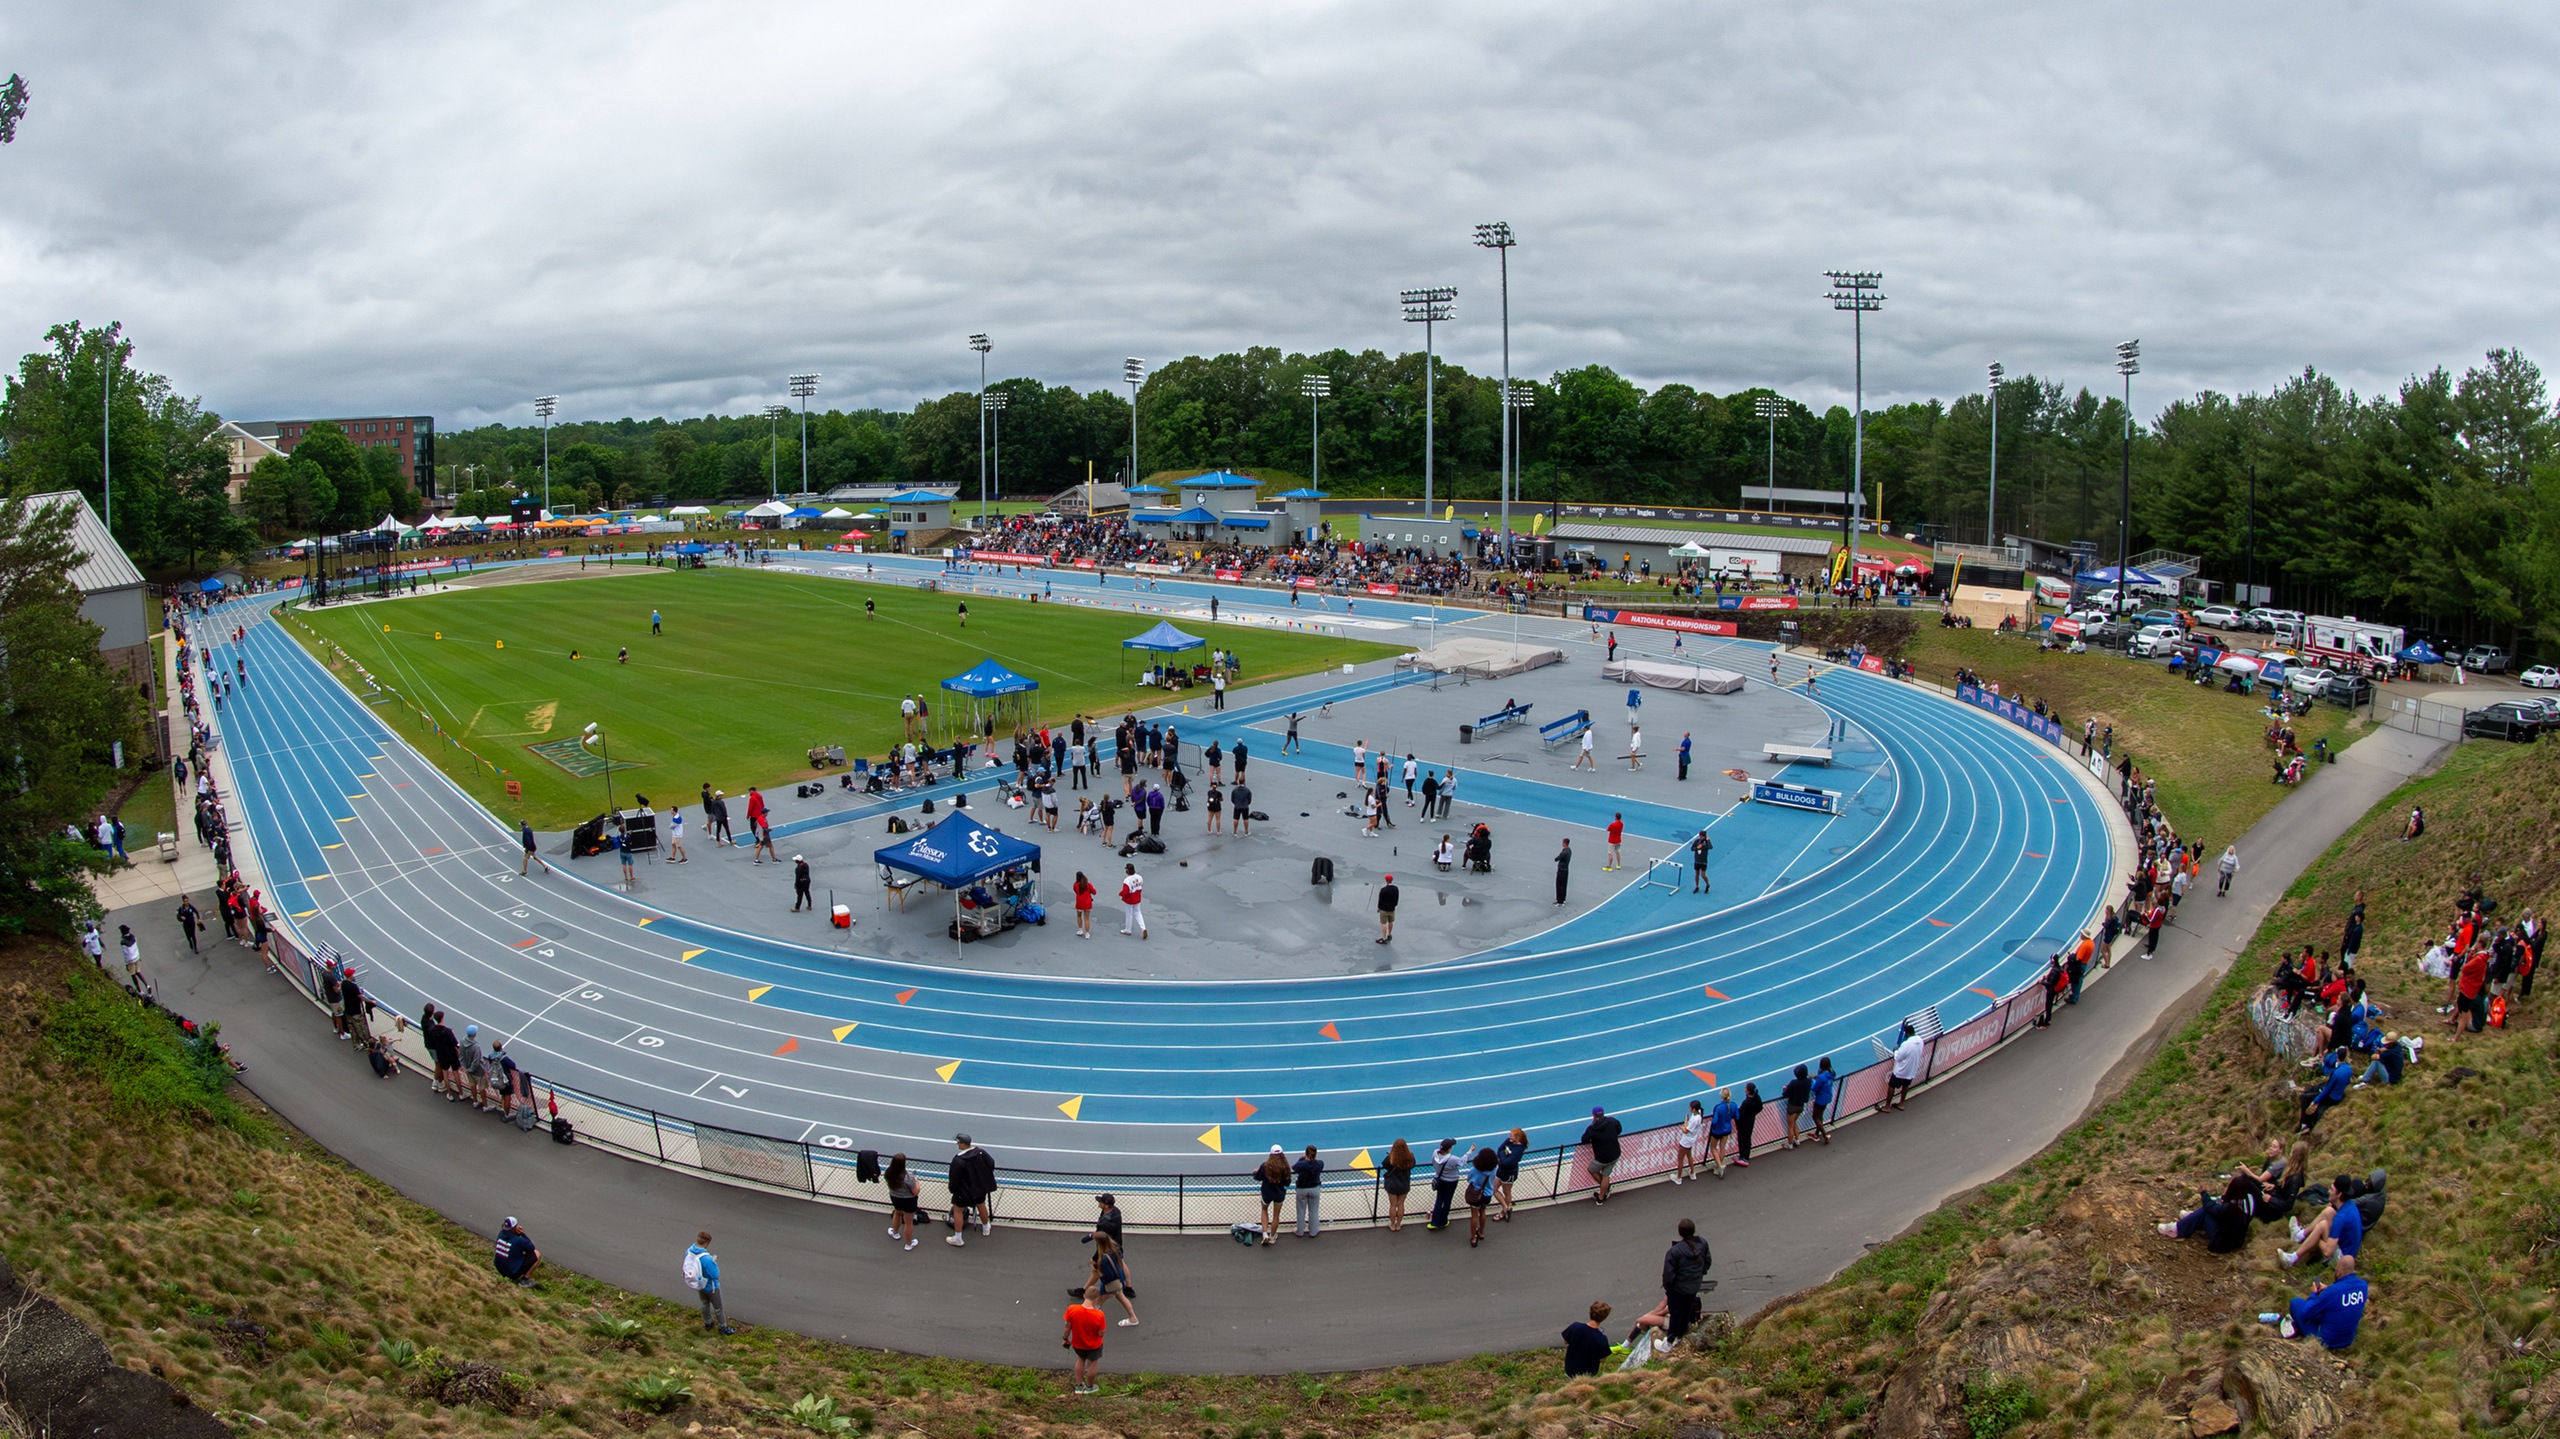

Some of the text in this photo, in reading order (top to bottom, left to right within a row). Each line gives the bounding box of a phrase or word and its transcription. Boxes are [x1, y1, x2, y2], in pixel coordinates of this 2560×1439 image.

[409, 560, 448, 569] CHAMPIONSHIP
[1729, 557, 1741, 565] GO
[1630, 615, 1722, 632] NATIONAL CHAMPIONSHIP
[1775, 792, 1816, 806] BULLDOGS
[538, 947, 555, 959] 4
[580, 989, 605, 1003] 5
[637, 1035, 666, 1048] 6
[719, 1084, 750, 1099] 7
[818, 1134, 854, 1150] 8
[2342, 1291, 2364, 1306] USA
